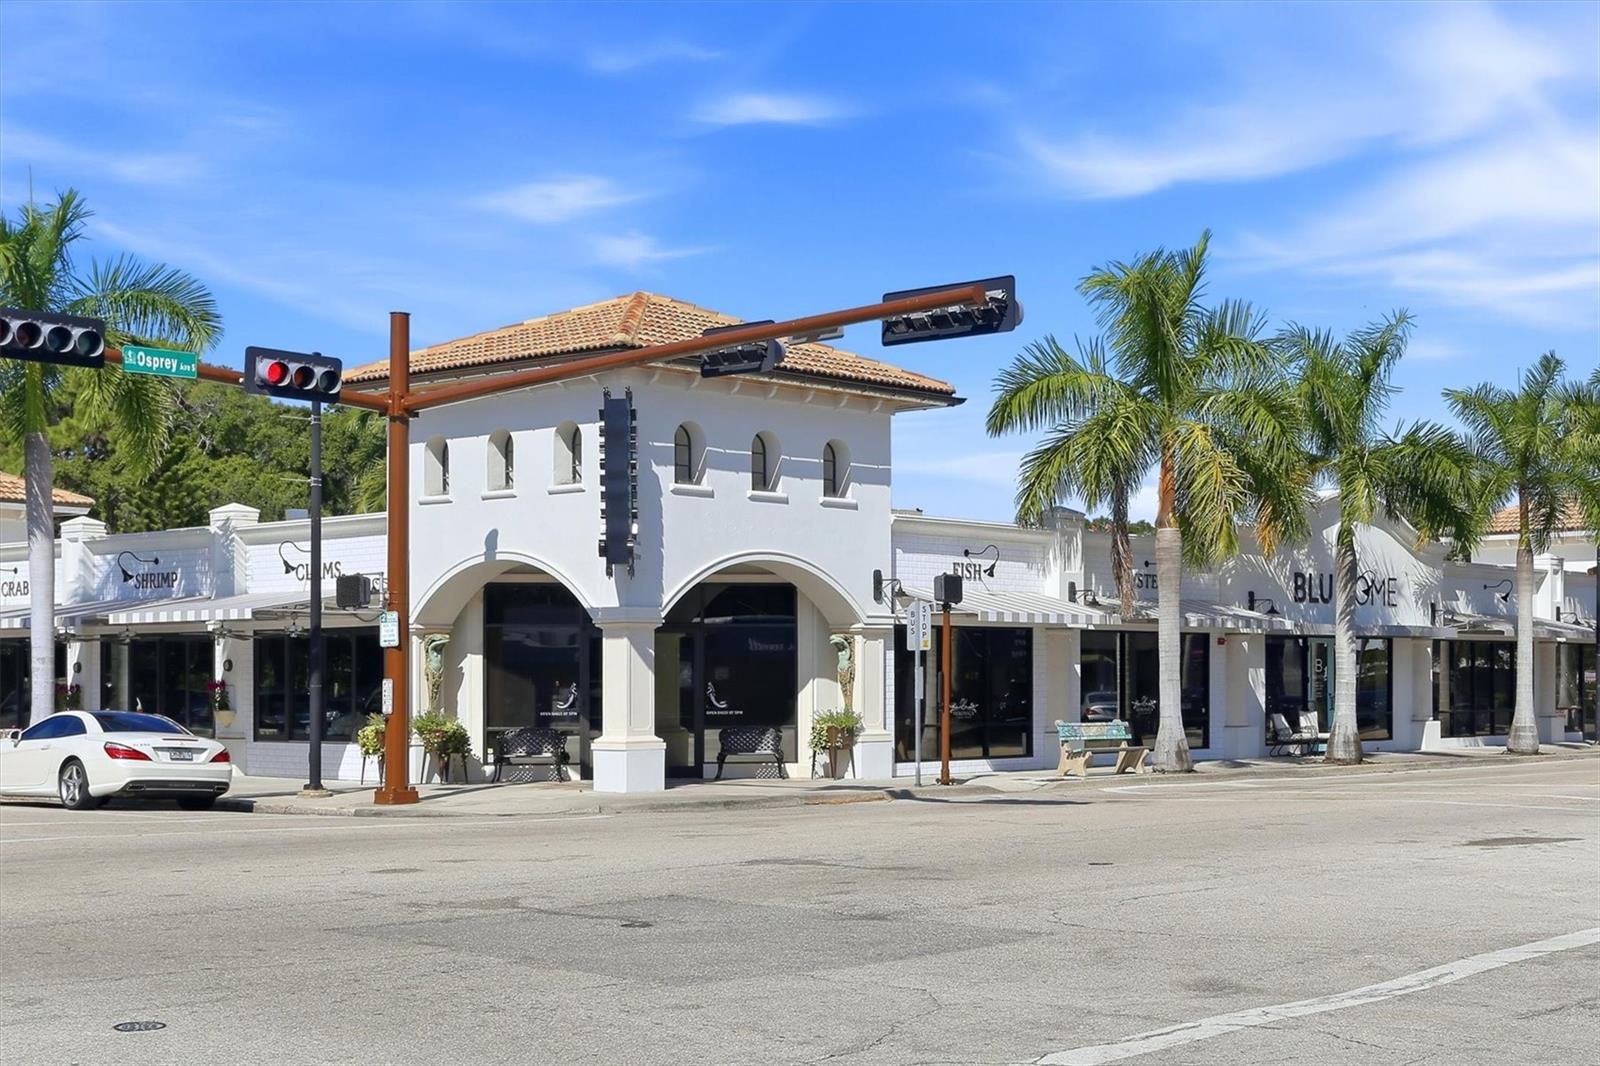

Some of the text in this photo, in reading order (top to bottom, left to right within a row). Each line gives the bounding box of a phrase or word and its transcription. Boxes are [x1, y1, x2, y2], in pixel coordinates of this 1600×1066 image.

[137, 351, 178, 373] Osprey
[134, 571, 178, 590] SHRIMP
[295, 561, 342, 581] CLMS
[953, 562, 982, 581] FISH
[1, 580, 30, 597] CRAB
[1293, 572, 1398, 607] BLU OME
